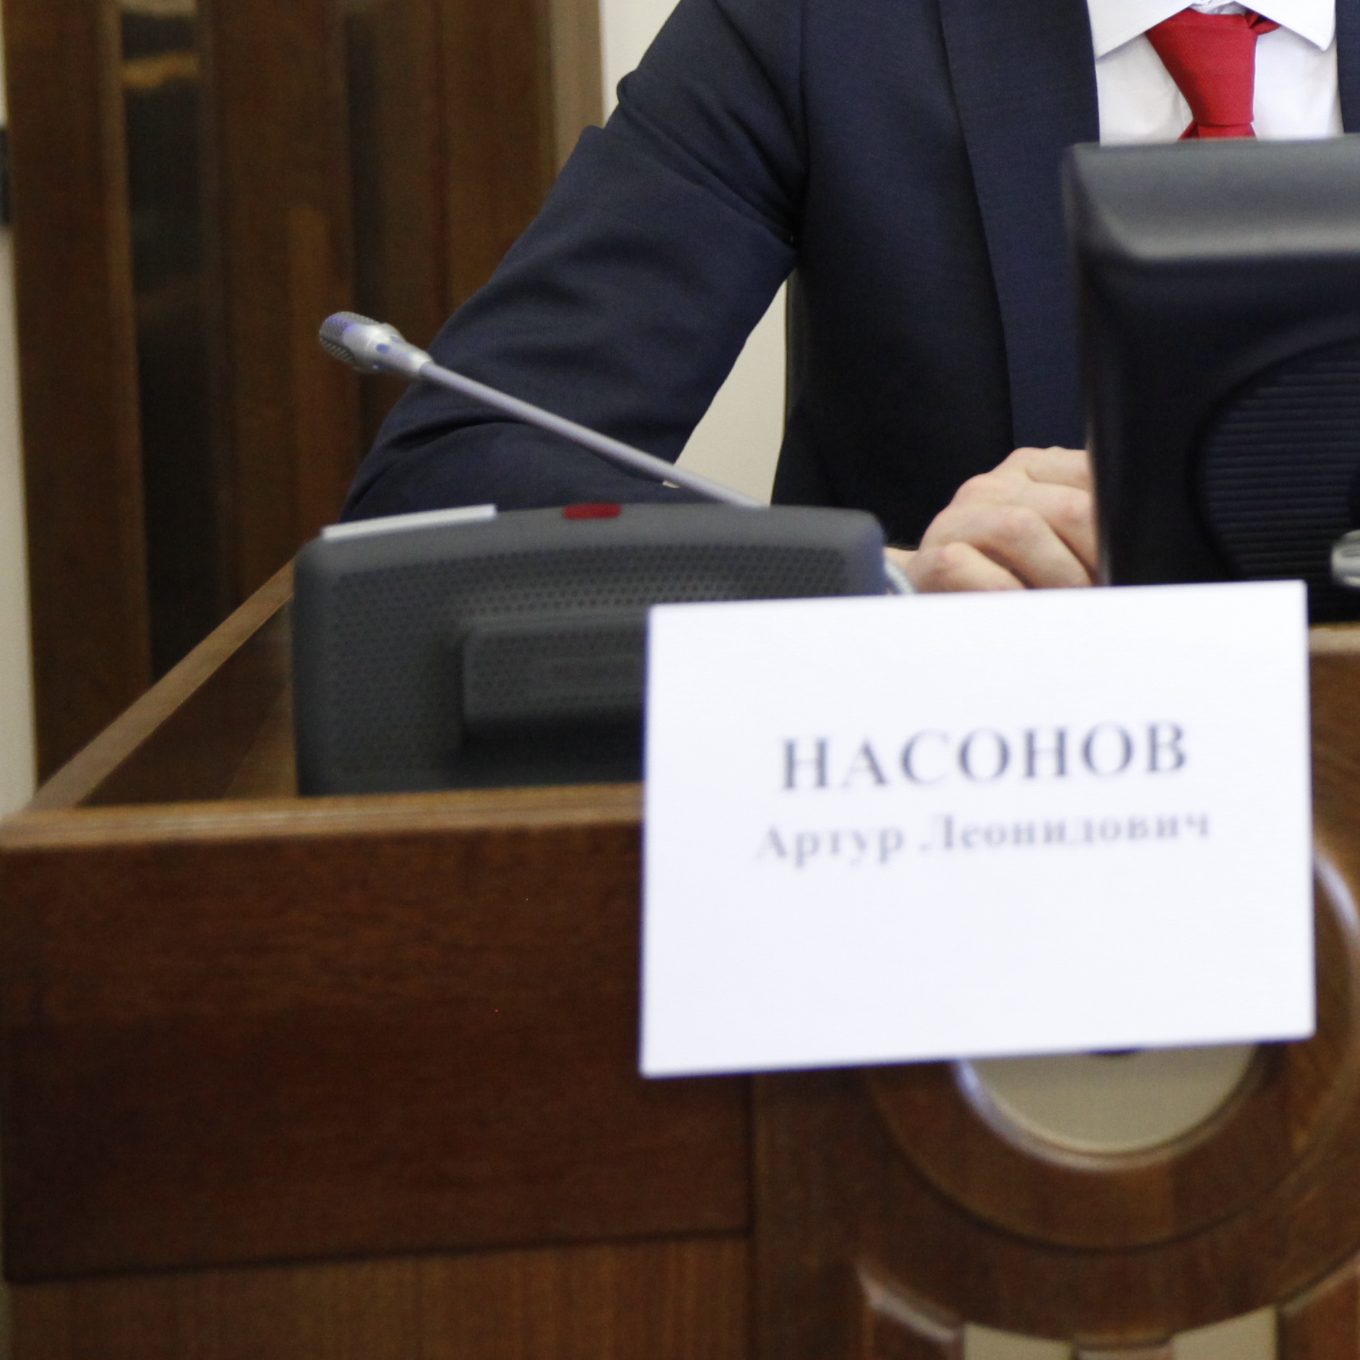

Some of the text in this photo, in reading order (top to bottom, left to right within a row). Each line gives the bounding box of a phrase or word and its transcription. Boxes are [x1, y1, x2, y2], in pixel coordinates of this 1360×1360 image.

[782, 721, 1188, 791] НАСОНОВ
[756, 812, 1210, 869] Артур Леонидович
